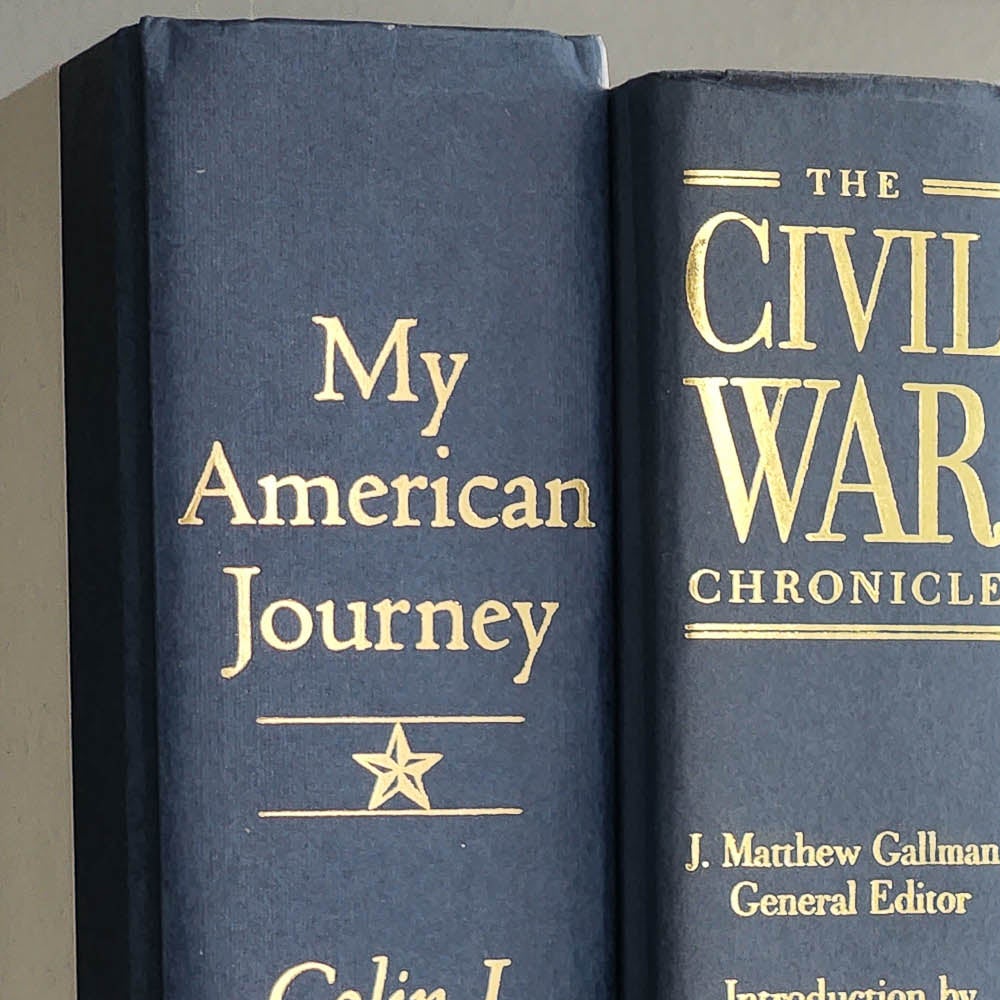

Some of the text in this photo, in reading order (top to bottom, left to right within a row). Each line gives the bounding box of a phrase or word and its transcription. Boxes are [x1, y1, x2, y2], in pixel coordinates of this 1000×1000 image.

[806, 168, 900, 198] THE
[312, 315, 469, 437] My
[178, 440, 596, 529] American
[220, 566, 559, 684] Journey
[685, 832, 710, 872] J.
[722, 832, 862, 868] Matthew
[730, 879, 972, 917] General Editor
